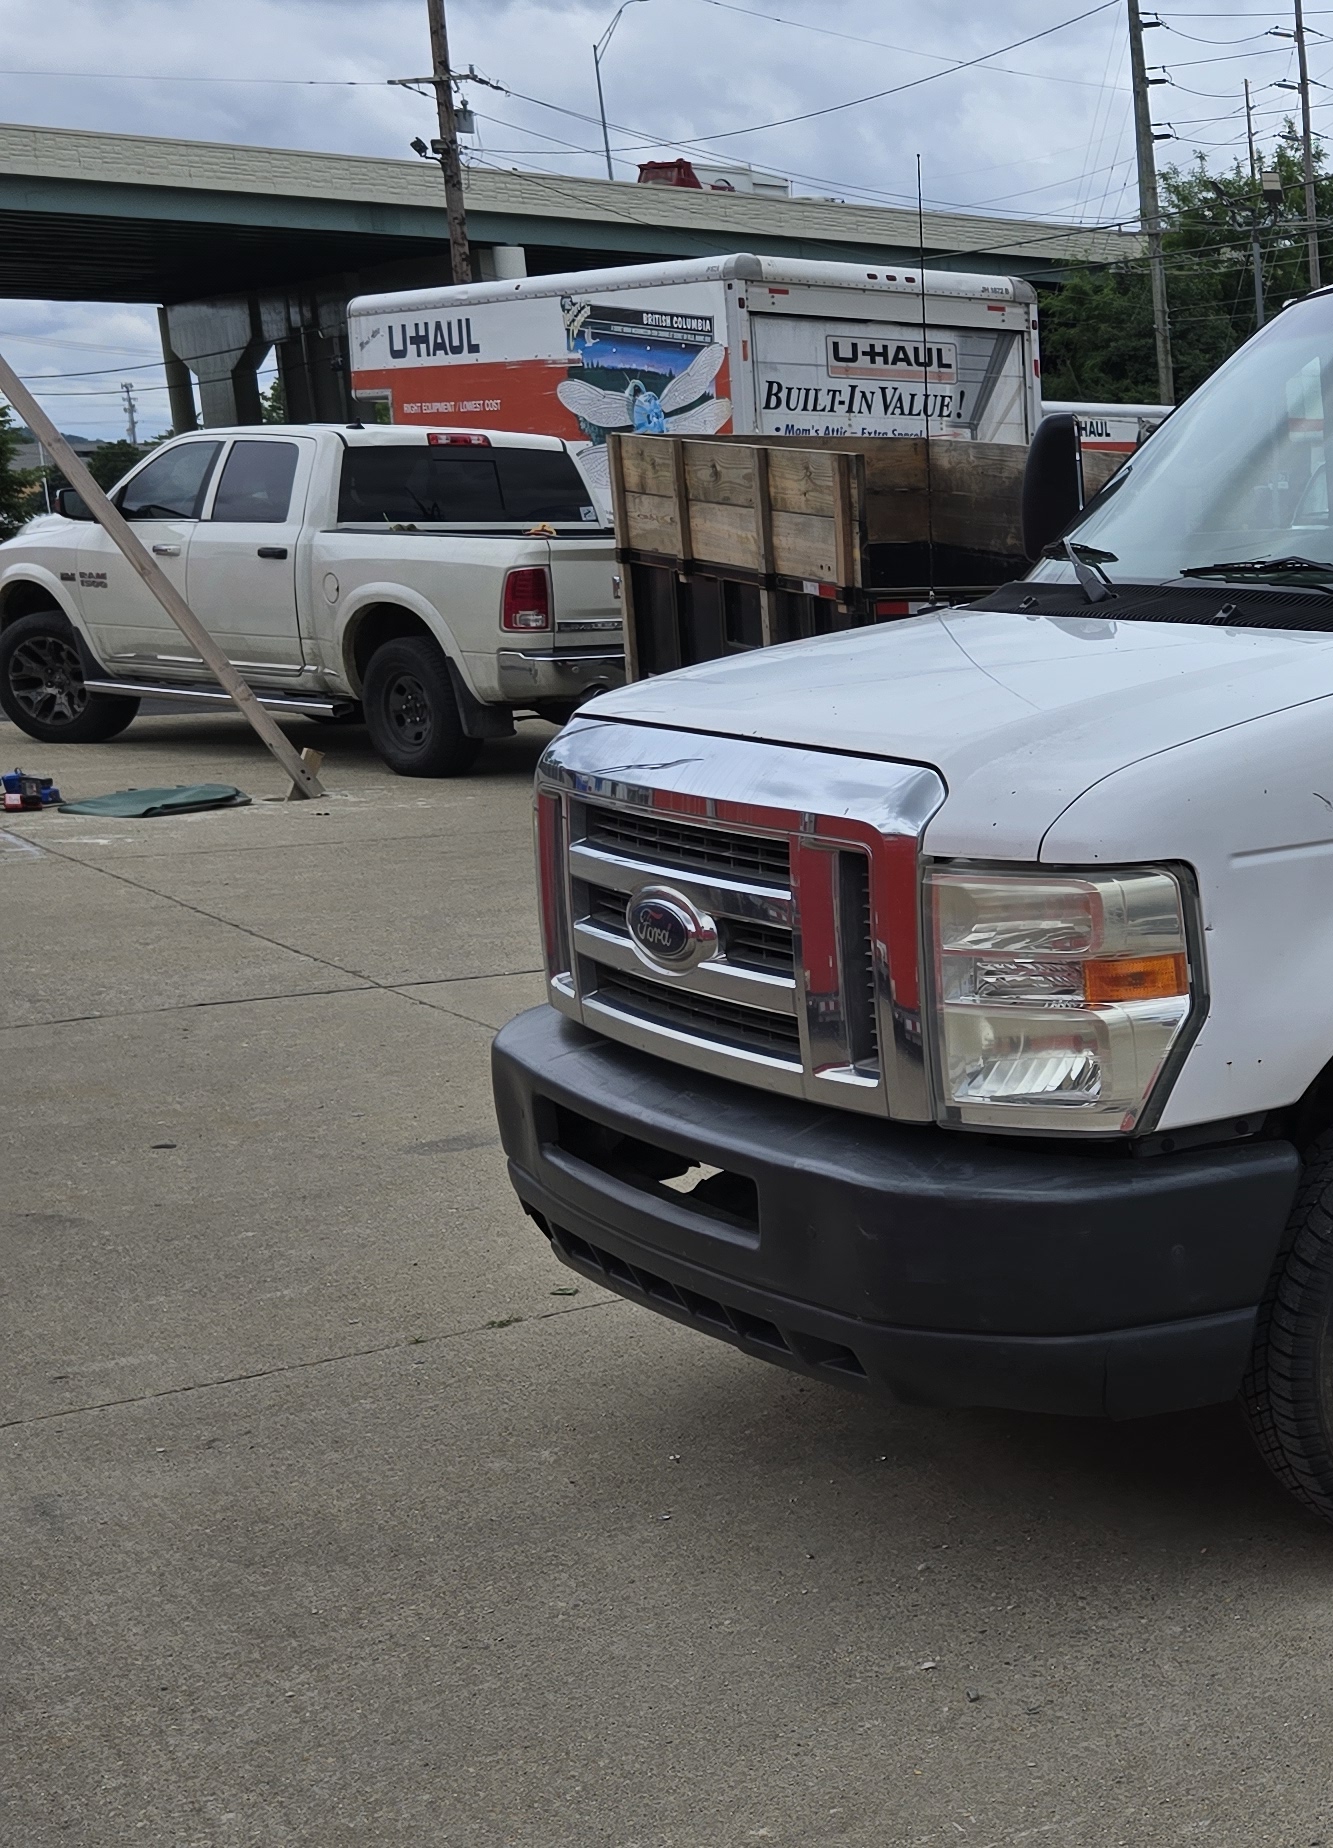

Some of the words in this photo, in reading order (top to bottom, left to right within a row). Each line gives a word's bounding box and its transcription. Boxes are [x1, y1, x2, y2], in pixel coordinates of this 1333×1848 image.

[643, 312, 671, 326] BRITISH
[672, 315, 711, 332] COLUMBIA
[388, 317, 481, 360] U-HAUL
[832, 341, 953, 370] U-HAUL
[485, 400, 501, 411] COST
[762, 380, 875, 415] BUILT-IN
[784, 424, 820, 436] Mom's
[1079, 420, 1111, 438] HAUL
[637, 907, 673, 947] Ford
